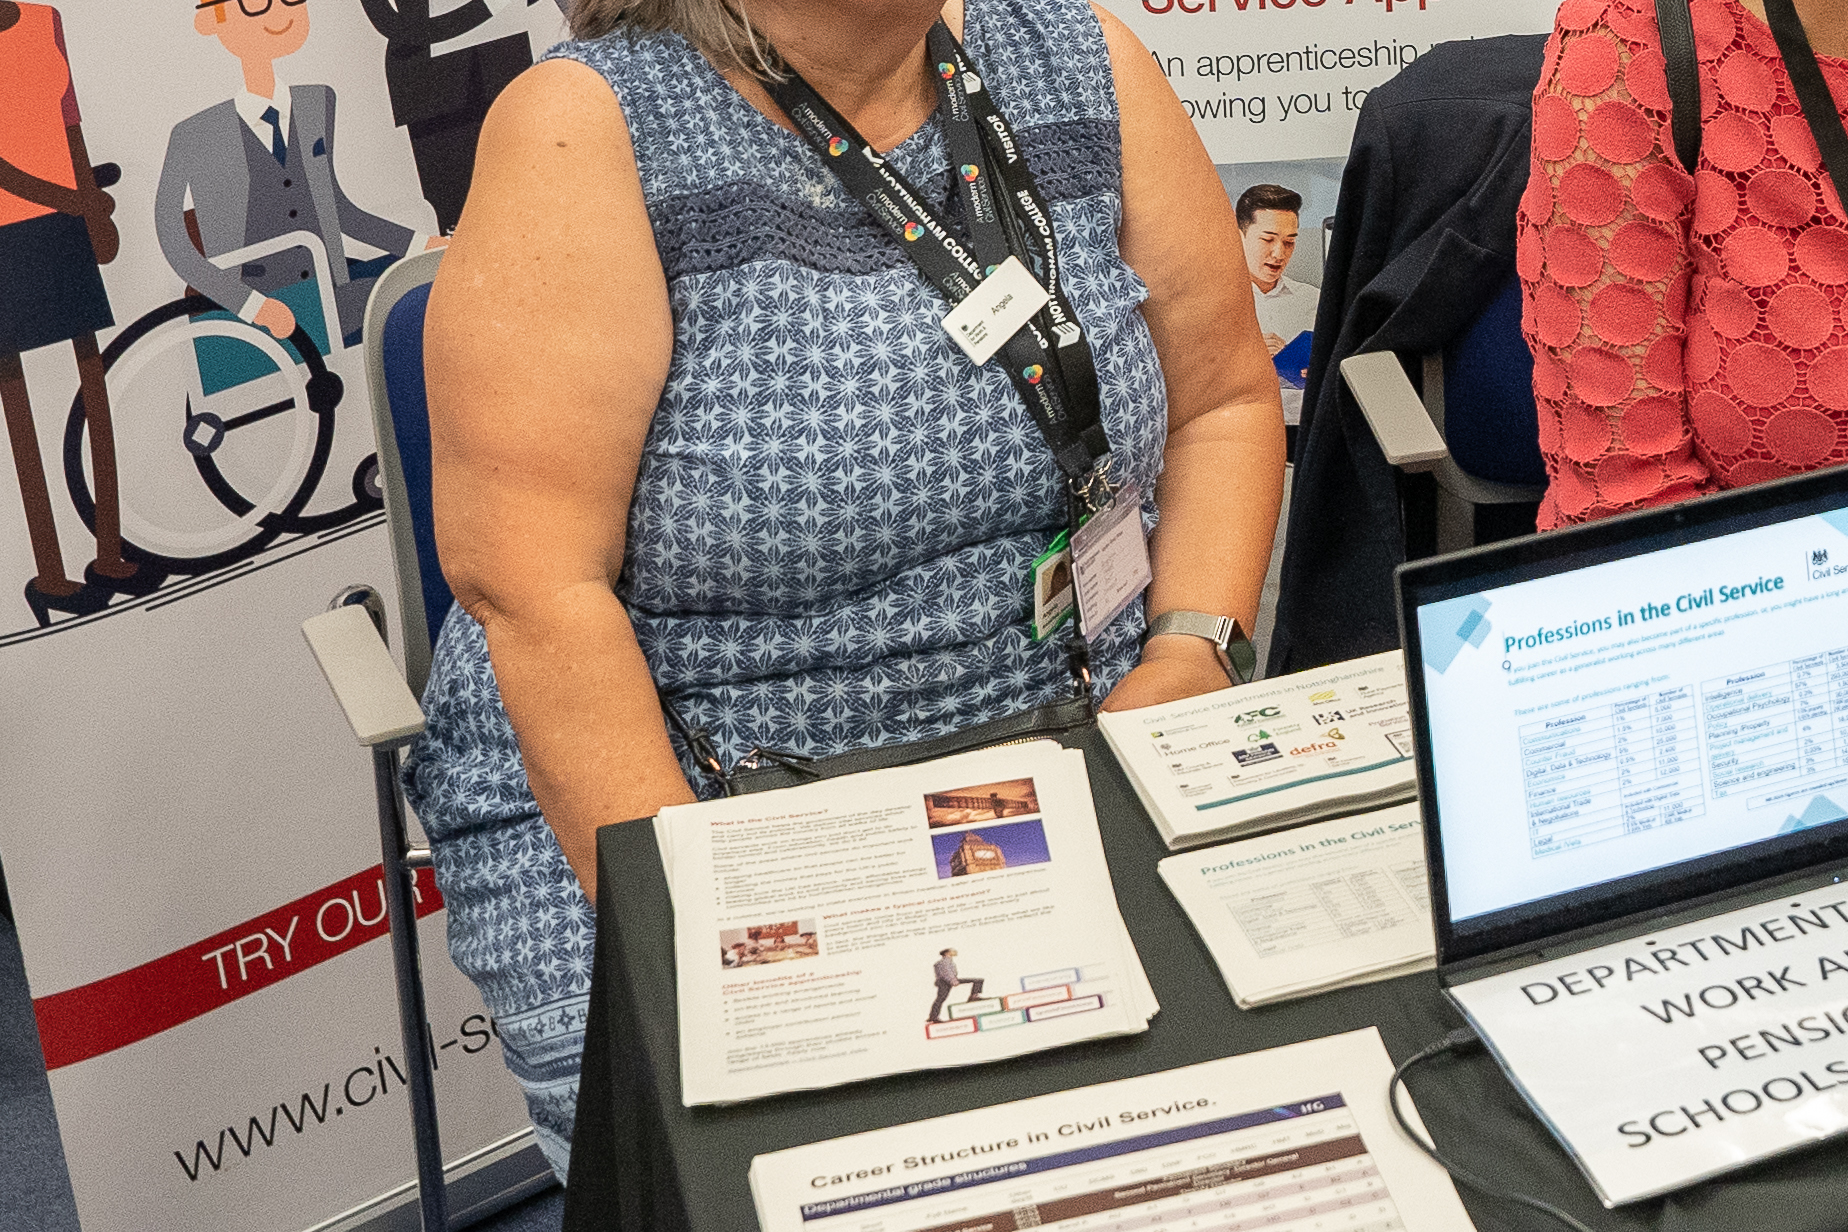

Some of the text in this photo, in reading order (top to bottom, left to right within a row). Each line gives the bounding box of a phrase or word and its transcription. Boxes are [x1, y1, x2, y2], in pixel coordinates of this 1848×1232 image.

[1196, 39, 1418, 83] apprenticeship
[804, 108, 833, 139] modern
[1277, 91, 1332, 121] you
[986, 114, 1018, 164] VISITOR
[879, 193, 908, 225] modern
[1016, 189, 1067, 324] NOTTINGHAM COLLEGE
[1812, 568, 1831, 580] Civil
[1505, 575, 1784, 654] Professions in the Civil Service
[1295, 666, 1385, 691] Nottinghamshire
[1163, 738, 1231, 758] Home Office
[1289, 741, 1337, 757] defra
[1201, 847, 1296, 877] Professions
[1300, 842, 1316, 853] in
[1320, 835, 1348, 848] the
[1350, 825, 1386, 841] Civil
[202, 915, 299, 989] TRY
[1521, 900, 1848, 1006] DEPARTMENT
[1641, 965, 1807, 1026] WORK
[810, 1095, 1218, 1190] Career Structure in Civil Service.
[803, 1186, 905, 1216] Departmental
[907, 1175, 951, 1196] grade
[954, 1161, 1028, 1183] structures
